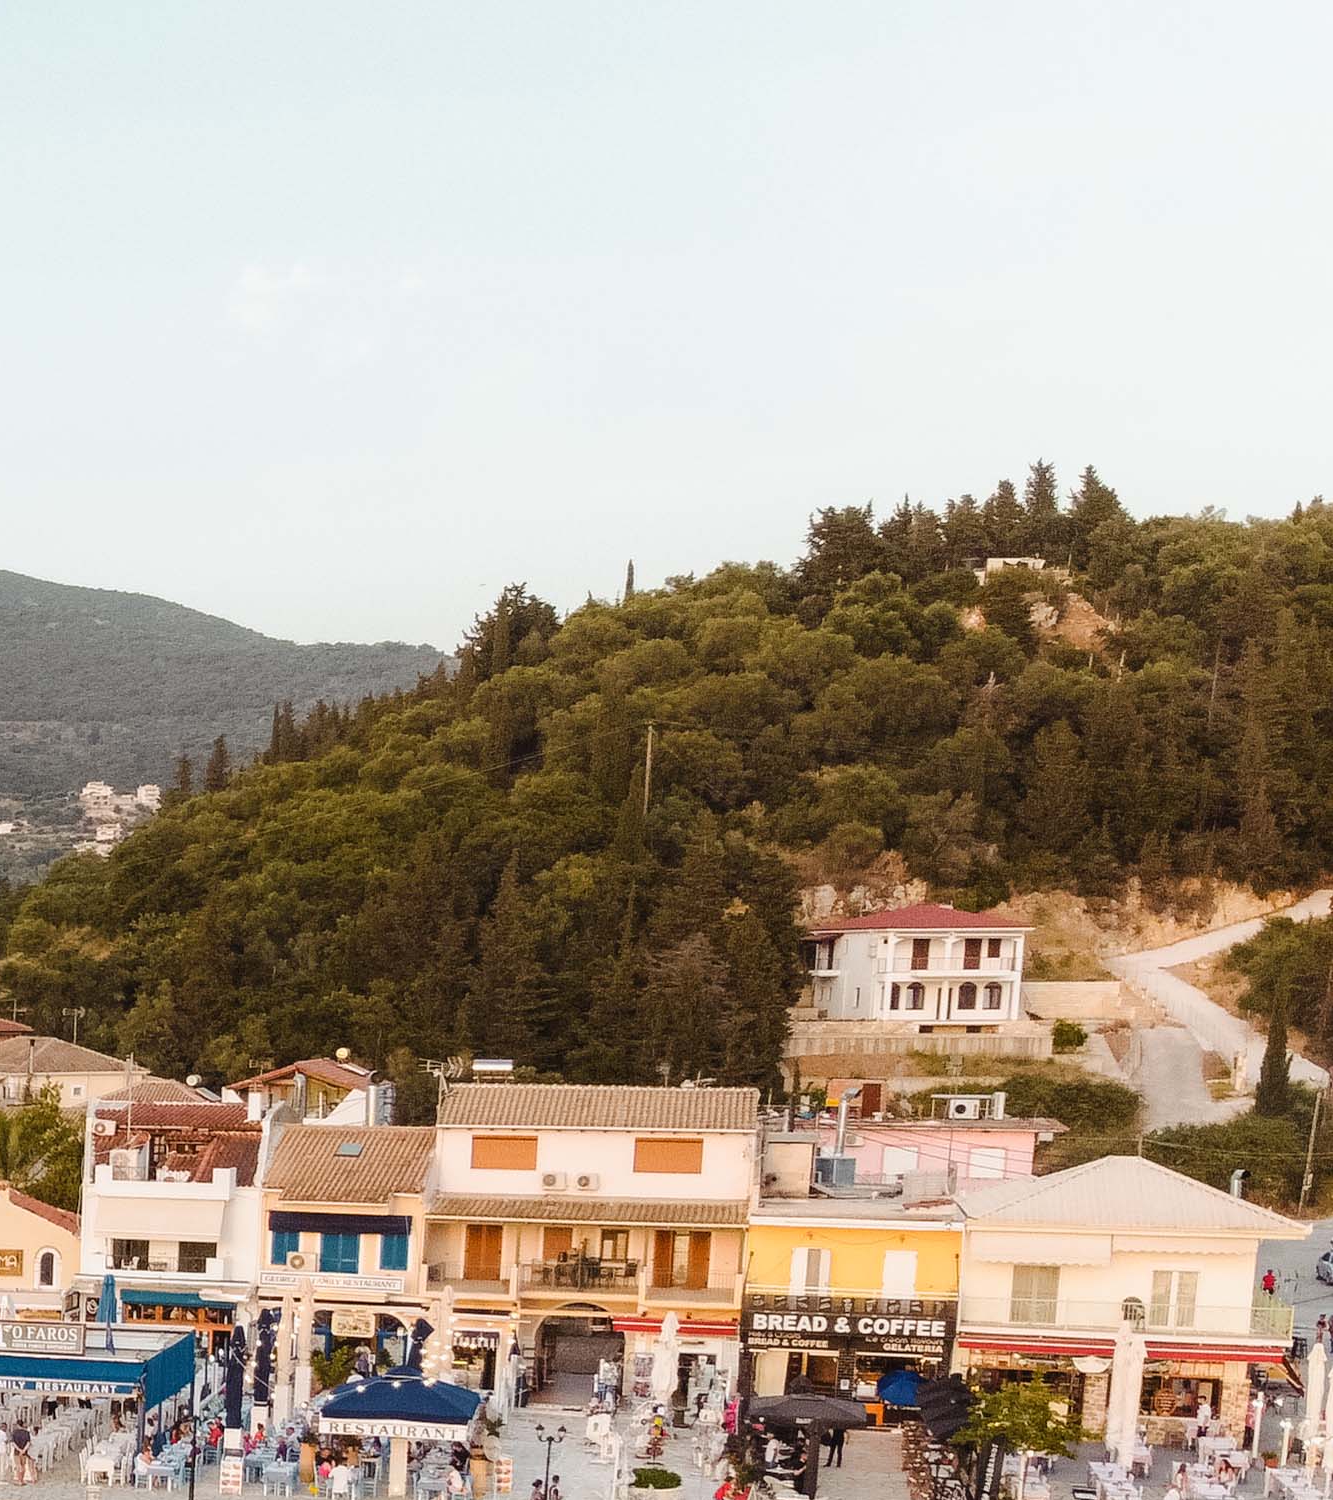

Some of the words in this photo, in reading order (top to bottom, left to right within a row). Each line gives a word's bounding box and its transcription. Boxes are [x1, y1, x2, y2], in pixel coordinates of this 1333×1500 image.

[343, 1279, 399, 1289] RESTAURANT
[753, 1313, 828, 1332] BREAD
[834, 1316, 851, 1333] &
[858, 1318, 946, 1336] COFFEE
[12, 1325, 23, 1339] O
[26, 1326, 78, 1341] FAROS
[748, 1337, 779, 1346] BREAD
[791, 1339, 829, 1349] COFFEE
[883, 1343, 944, 1353] GELATERIA
[35, 1382, 117, 1394] RESTAURANT
[329, 1422, 458, 1439] RESTAURANT
